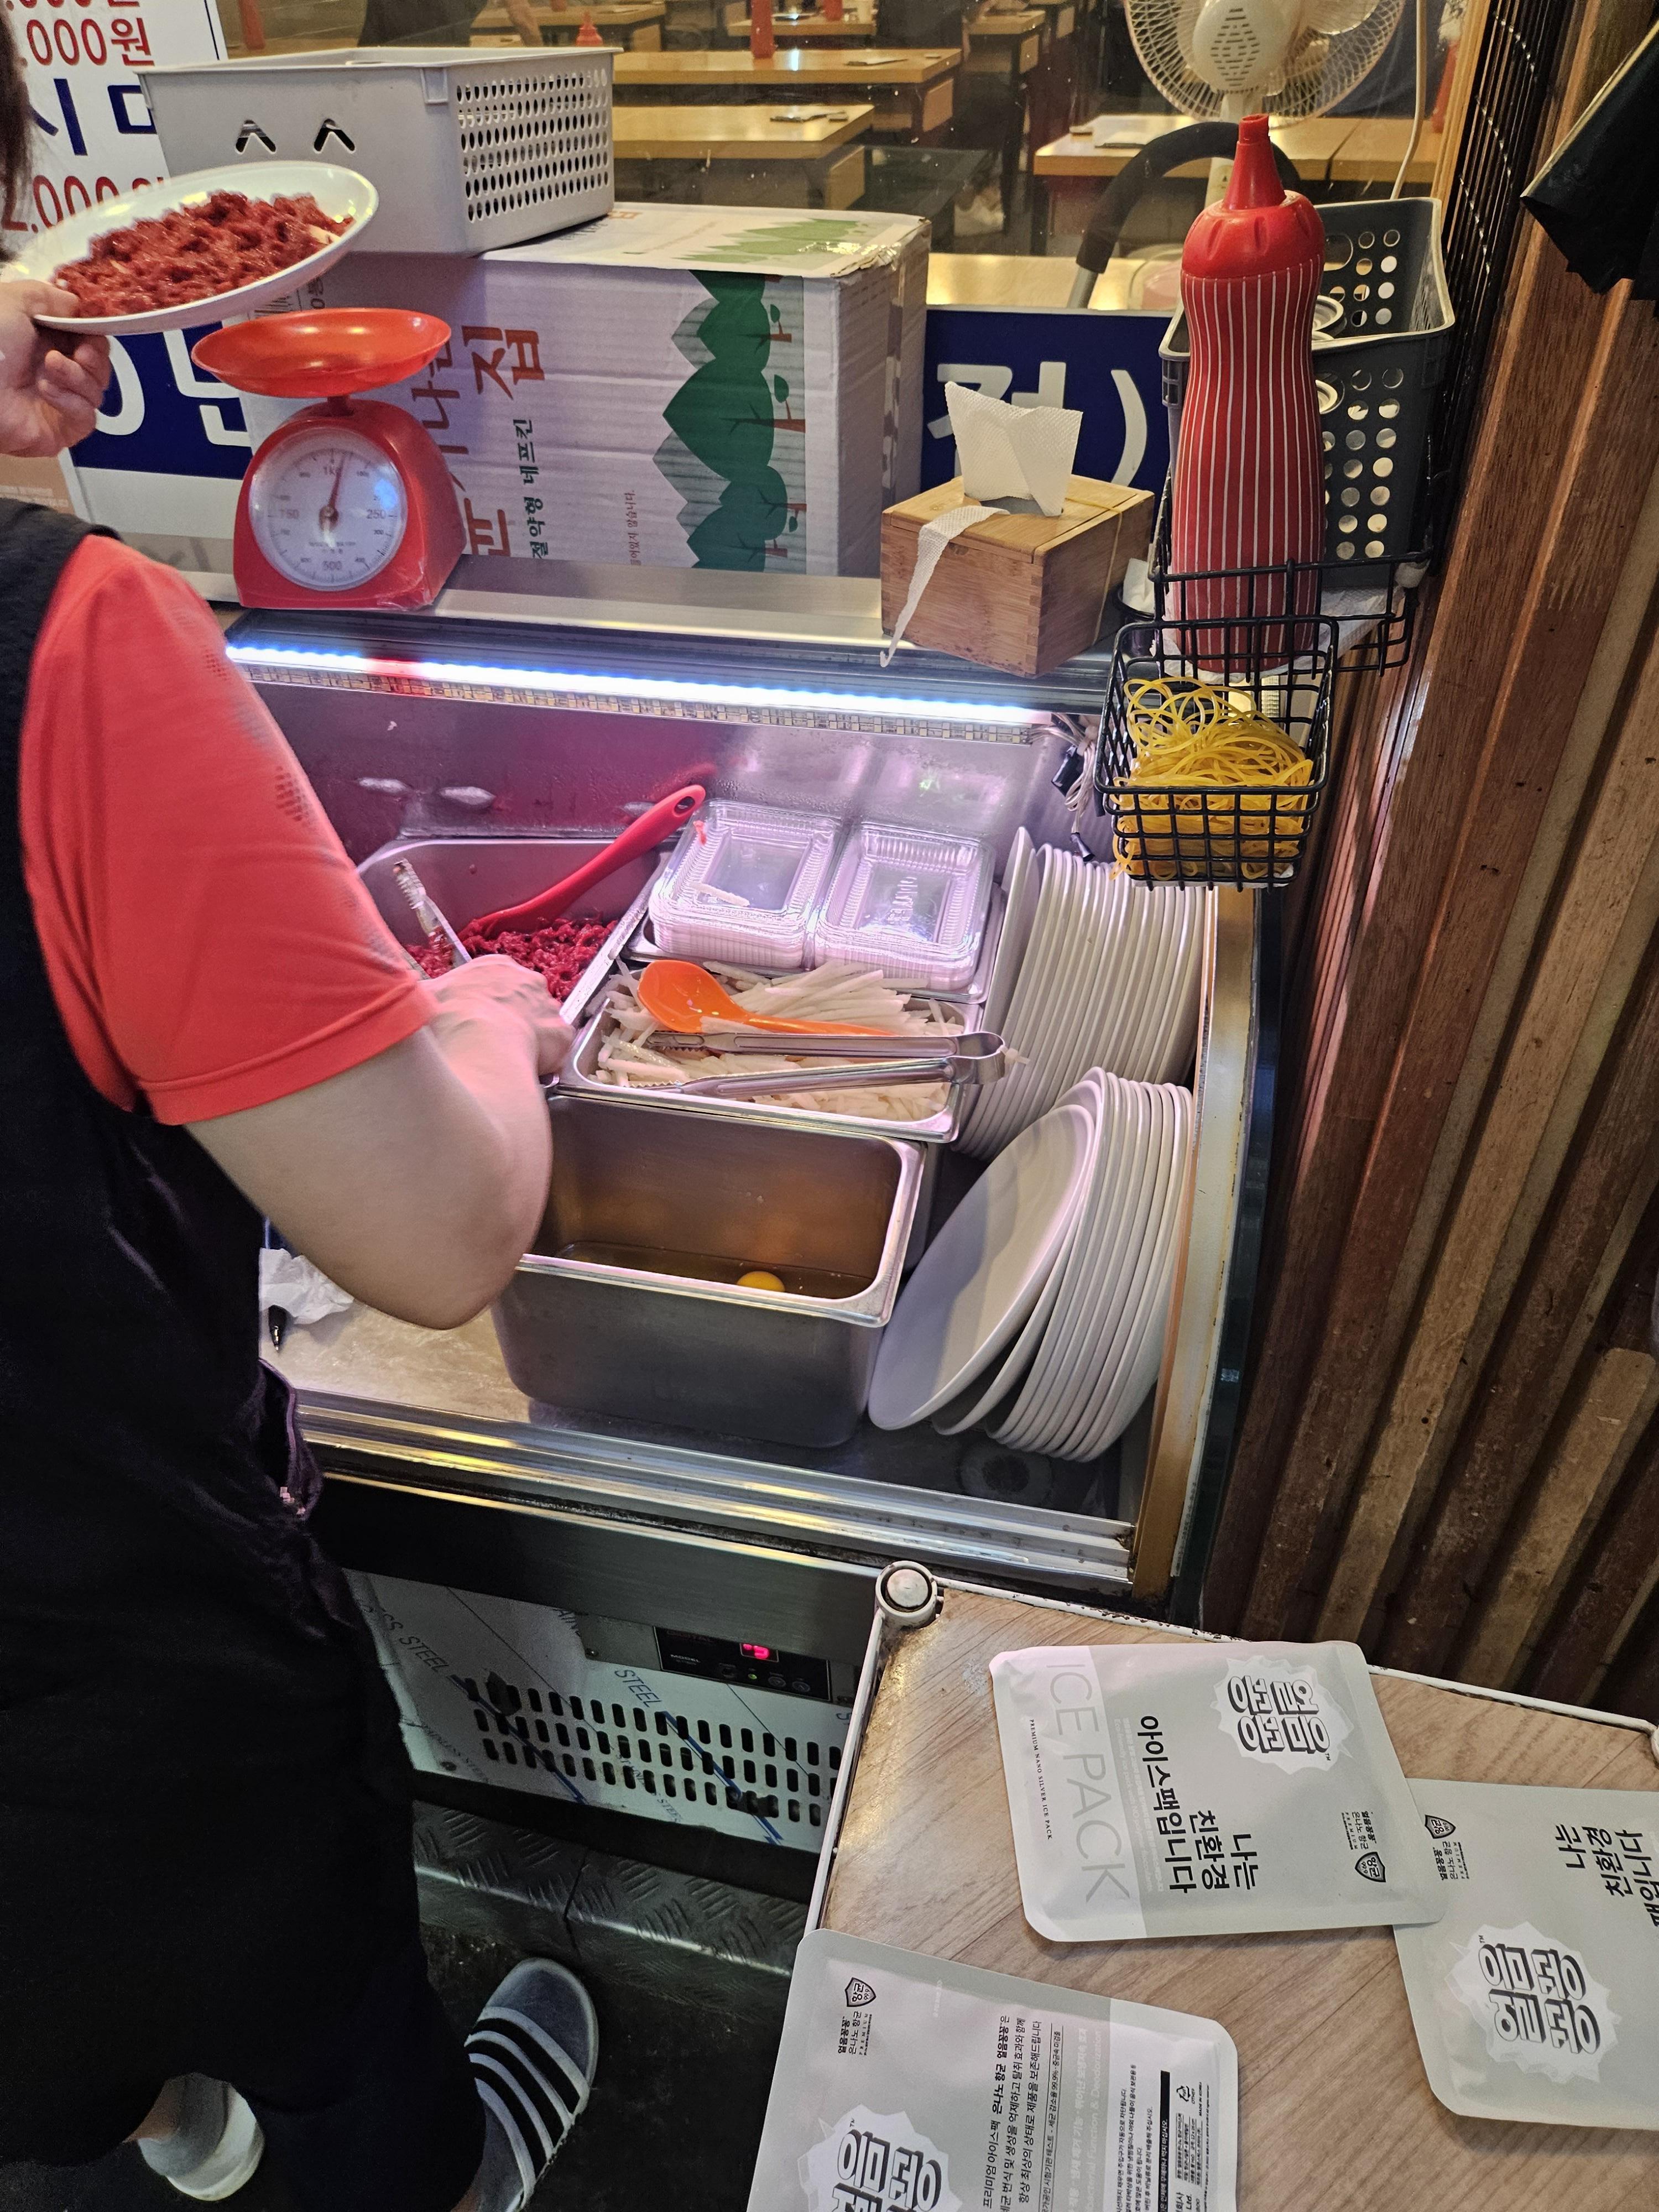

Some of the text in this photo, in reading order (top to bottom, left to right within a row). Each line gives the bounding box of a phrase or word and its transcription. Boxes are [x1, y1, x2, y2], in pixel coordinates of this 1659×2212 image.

[462, 325, 545, 399] 집
[513, 419, 549, 559] 절약형 네프킨
[367, 509, 385, 519] 250
[399, 1636, 449, 1672] STEEL
[614, 1669, 662, 1708] STEEL
[1227, 1674, 1281, 1754] 꽁꽁
[1271, 1679, 1330, 1754] 얼음
[1029, 1719, 1039, 1751] PREMIUM
[1037, 1776, 1047, 1802] SILVER
[1044, 1819, 1052, 1840] PACK
[1046, 1663, 1130, 1903] ICE PACK
[1131, 1805, 1140, 1818] NO
[1138, 1715, 1191, 1894] 아이스팩입니다
[1352, 1812, 1369, 1849] 은나노 항균
[1431, 1819, 1444, 1834] 항균
[1554, 1823, 1586, 1869] 나는
[1188, 1810, 1230, 1891] 친환경
[1231, 1832, 1259, 1891] 나는
[1367, 1857, 1380, 1877] 항균
[1443, 1841, 1458, 1879] 은나노 항균
[1582, 1825, 1635, 1897] 친환경
[852, 1983, 864, 2002] 항균
[1478, 1943, 1546, 2044] 얼음
[1531, 1949, 1601, 2055] 꽁꽁
[848, 2011, 862, 2054] 은나노 항균
[1015, 2017, 1025, 2033] 함께
[1014, 2034, 1024, 2060] 효과와
[995, 2063, 1005, 2081] 항균
[1012, 2062, 1022, 2079] 탈취
[992, 2083, 1004, 2114] 은나노
[1008, 2081, 1021, 2122] 억제하고
[1018, 2021, 1042, 2203] 항상 최상의 상태로 제품을 보존해드립니다
[987, 2120, 1000, 2162] 아이스팩
[1005, 2125, 1017, 2156] 생성을
[1044, 2157, 1052, 2185] 시험기관
[1048, 2113, 1056, 2127] 세균
[1001, 2171, 1013, 2192] 번식
[1004, 2158, 1014, 2168] 및
[984, 2164, 996, 2208] 프리미엄
